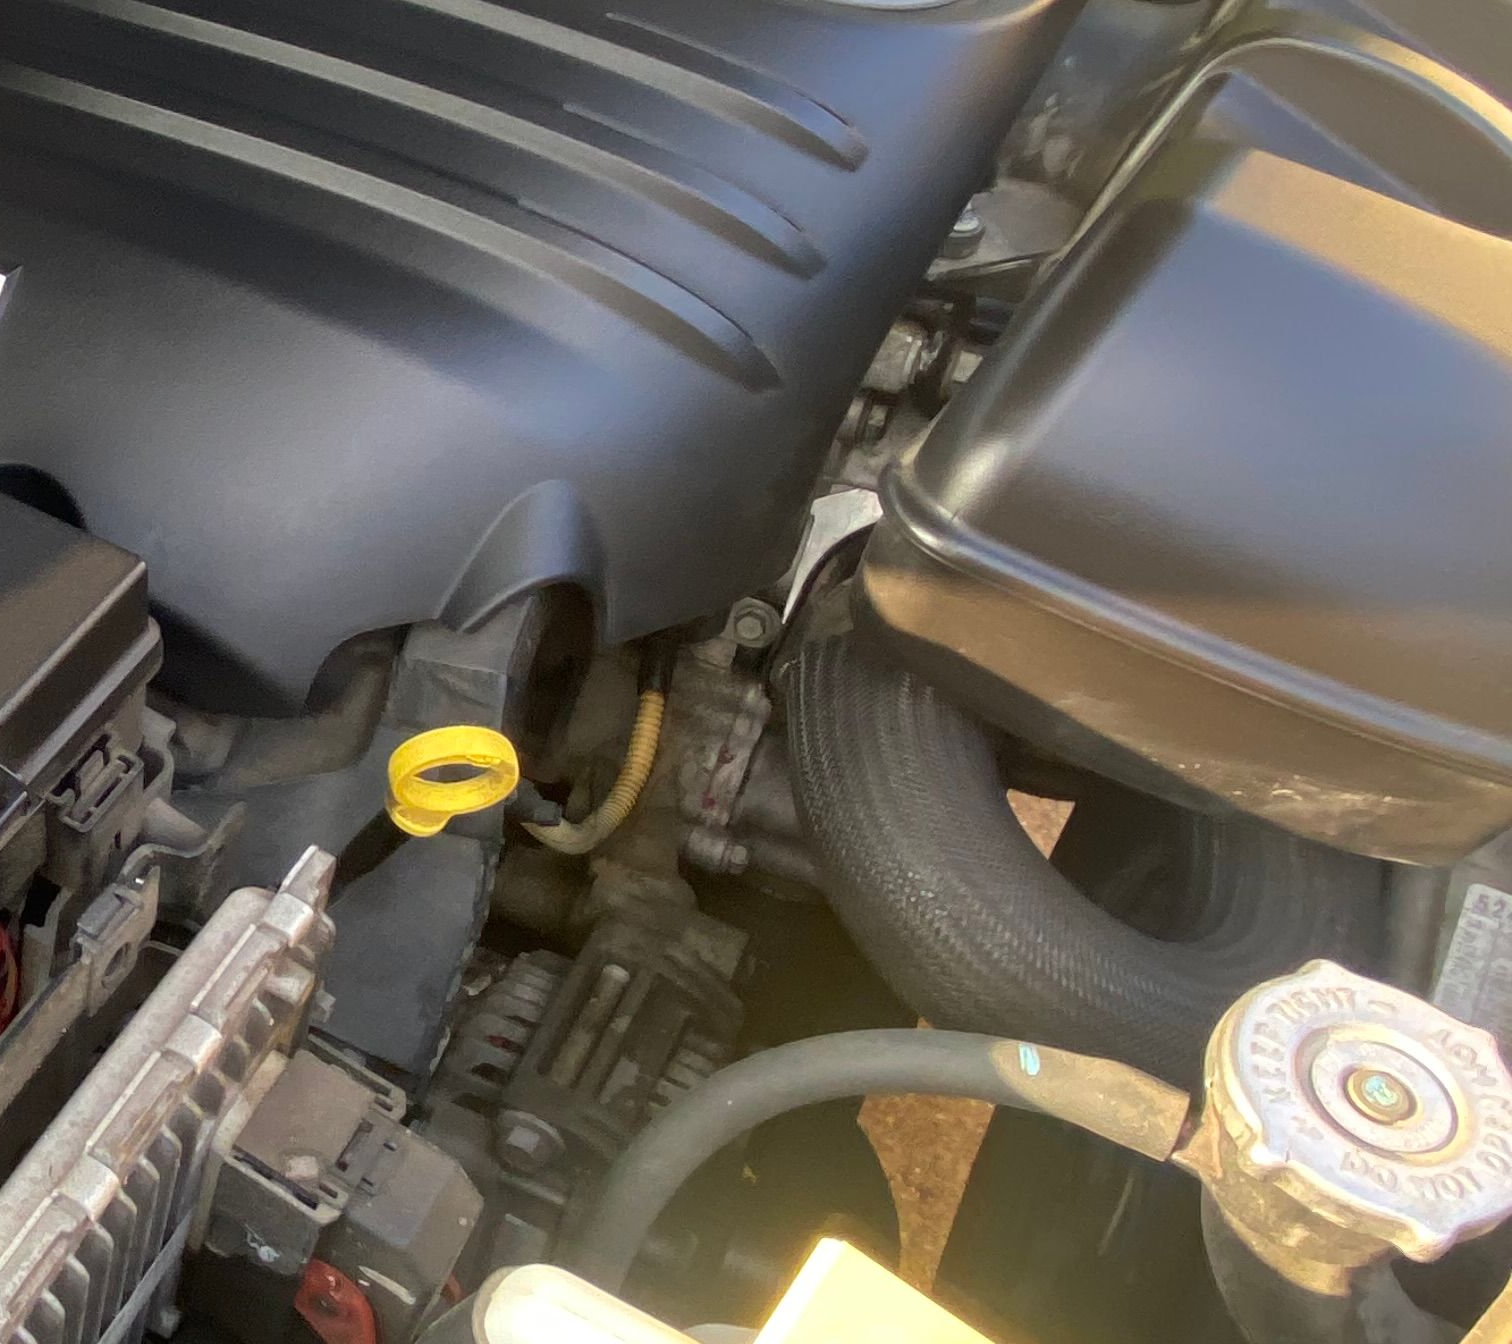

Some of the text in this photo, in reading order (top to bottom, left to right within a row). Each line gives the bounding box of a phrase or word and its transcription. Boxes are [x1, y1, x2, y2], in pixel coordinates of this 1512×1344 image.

[1250, 1022, 1293, 1103] KEEP
[1342, 1149, 1398, 1193] DO
[1407, 1166, 1483, 1201] NOT
